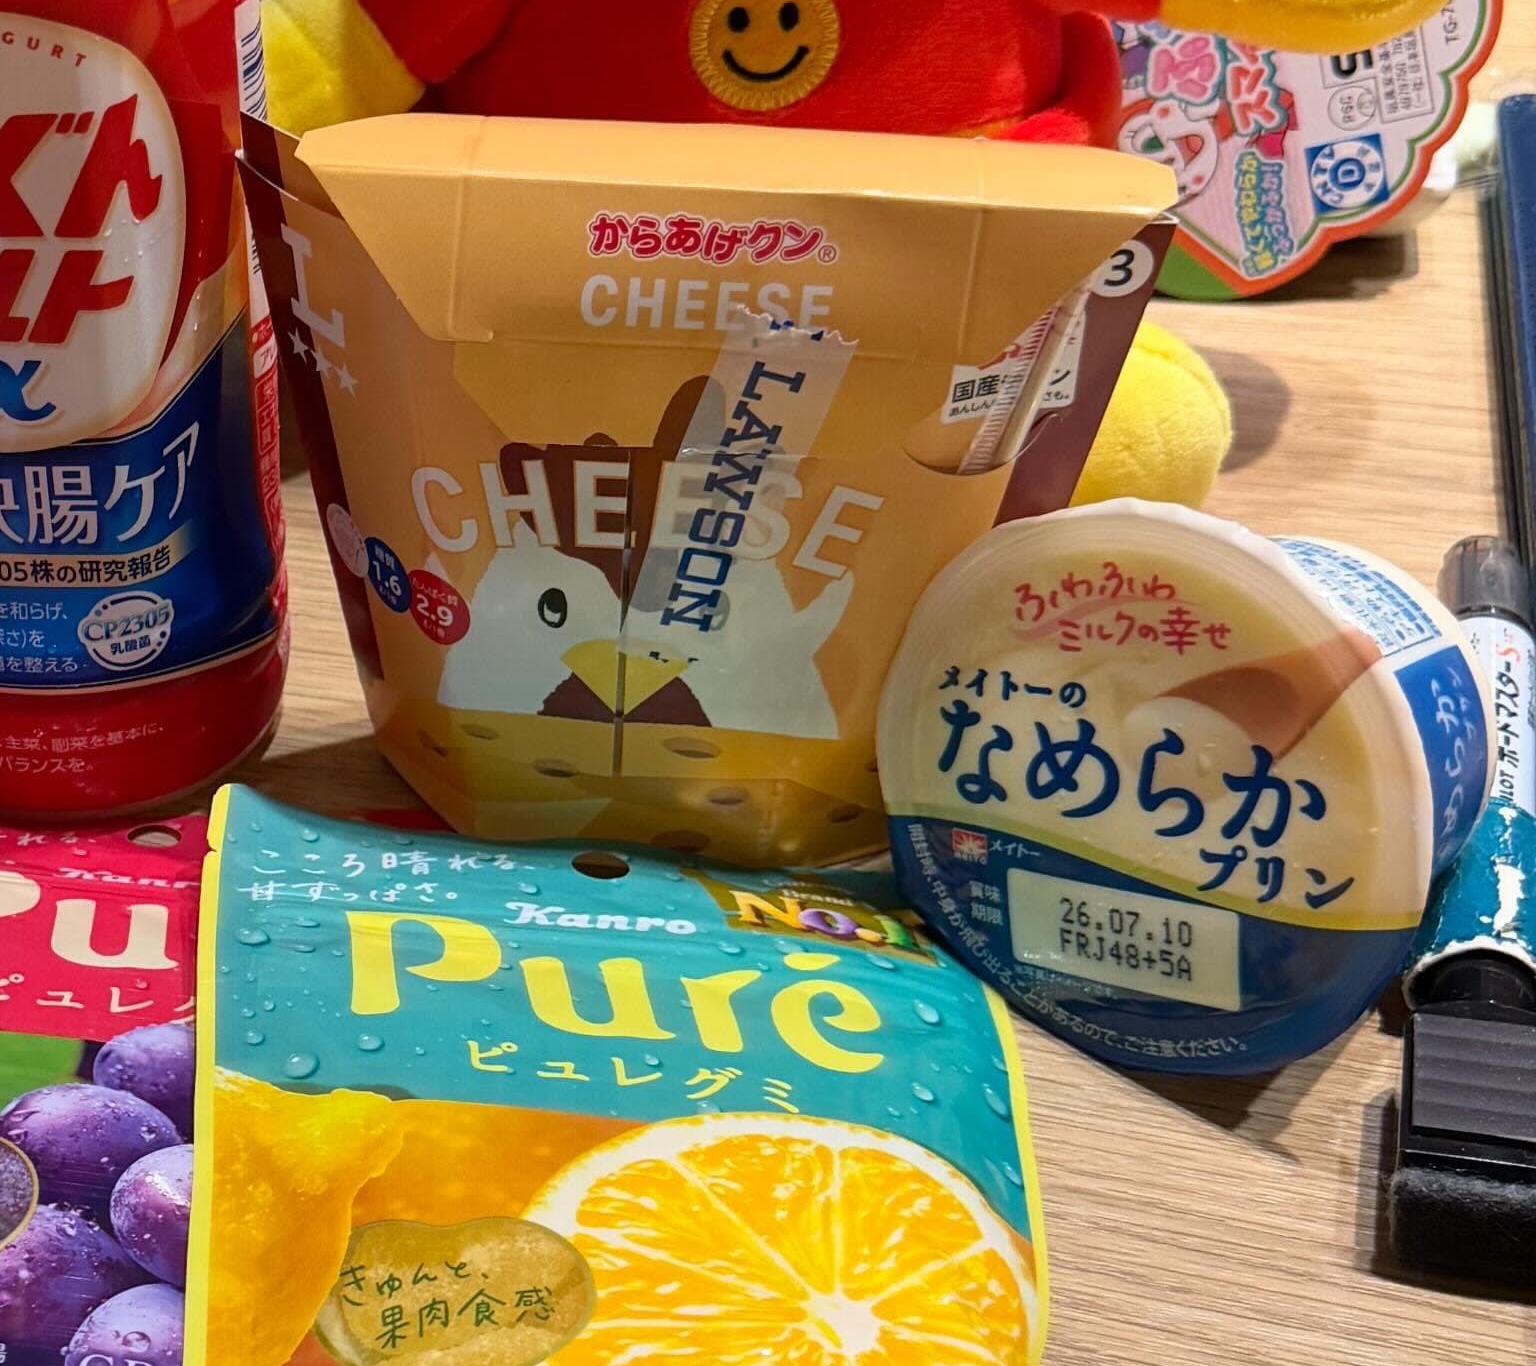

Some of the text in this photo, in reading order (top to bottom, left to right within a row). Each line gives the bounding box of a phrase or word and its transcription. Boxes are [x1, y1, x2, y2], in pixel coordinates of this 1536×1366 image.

[1, 30, 88, 68] GURT
[589, 212, 824, 263] からあげクン
[1104, 249, 1134, 287] 3
[580, 274, 834, 334] CHEESE
[661, 361, 806, 633] LAWSON
[411, 459, 885, 581] CHEESE
[83, 601, 172, 643] CP2305
[417, 594, 453, 626] 2.9
[1057, 607, 1232, 654] ミルクの幸せ
[110, 637, 151, 655] 乳酸菌
[939, 665, 1088, 709] メイトーの
[938, 698, 1328, 848] なめらか
[253, 849, 535, 876] こころ晴れる、
[989, 839, 1041, 859] メイトー
[238, 880, 458, 903] 甘ずっぱさ。
[969, 880, 1001, 903] 賞味
[1197, 847, 1356, 910] プリン
[503, 901, 698, 936] Kanro
[971, 902, 1003, 926] 期限
[1059, 897, 1194, 947] 26.07.10
[1059, 928, 1194, 984] FRJ48+5A
[465, 1039, 801, 1114] ピュレグミ
[339, 1260, 490, 1307] きゅんと、
[375, 1286, 556, 1350] 果肉食感
